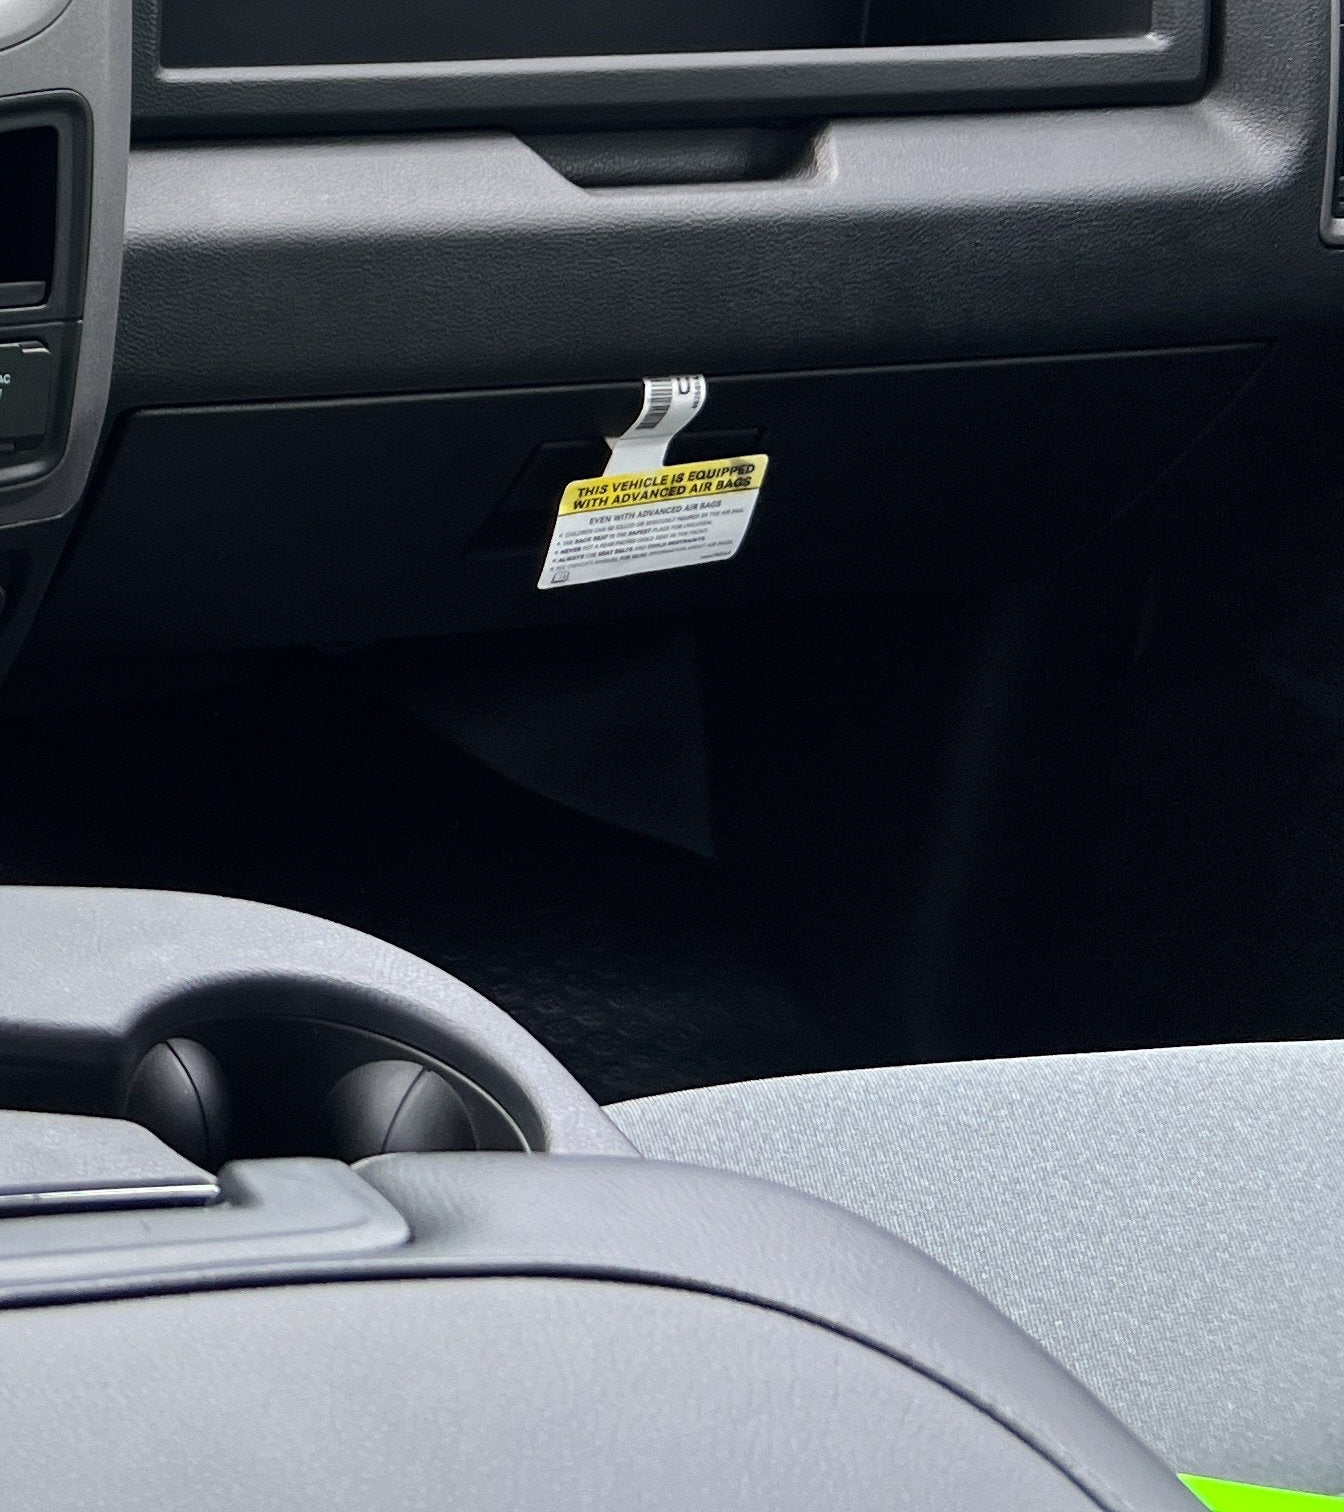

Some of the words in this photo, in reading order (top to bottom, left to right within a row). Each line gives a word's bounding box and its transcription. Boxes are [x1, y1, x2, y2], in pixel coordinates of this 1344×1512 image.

[573, 496, 610, 511] WITH
[611, 486, 686, 506] ADVANCED
[689, 482, 712, 495] AIR
[716, 476, 752, 490] BAGS
[577, 484, 608, 499] THIS
[612, 475, 668, 492] VEHICLE
[671, 473, 685, 485] IS
[687, 464, 755, 482] EQUIPPED
[589, 515, 612, 526] EVEN
[613, 512, 635, 522] WITH
[636, 505, 683, 518] ADVANCED
[683, 503, 699, 513] AIR
